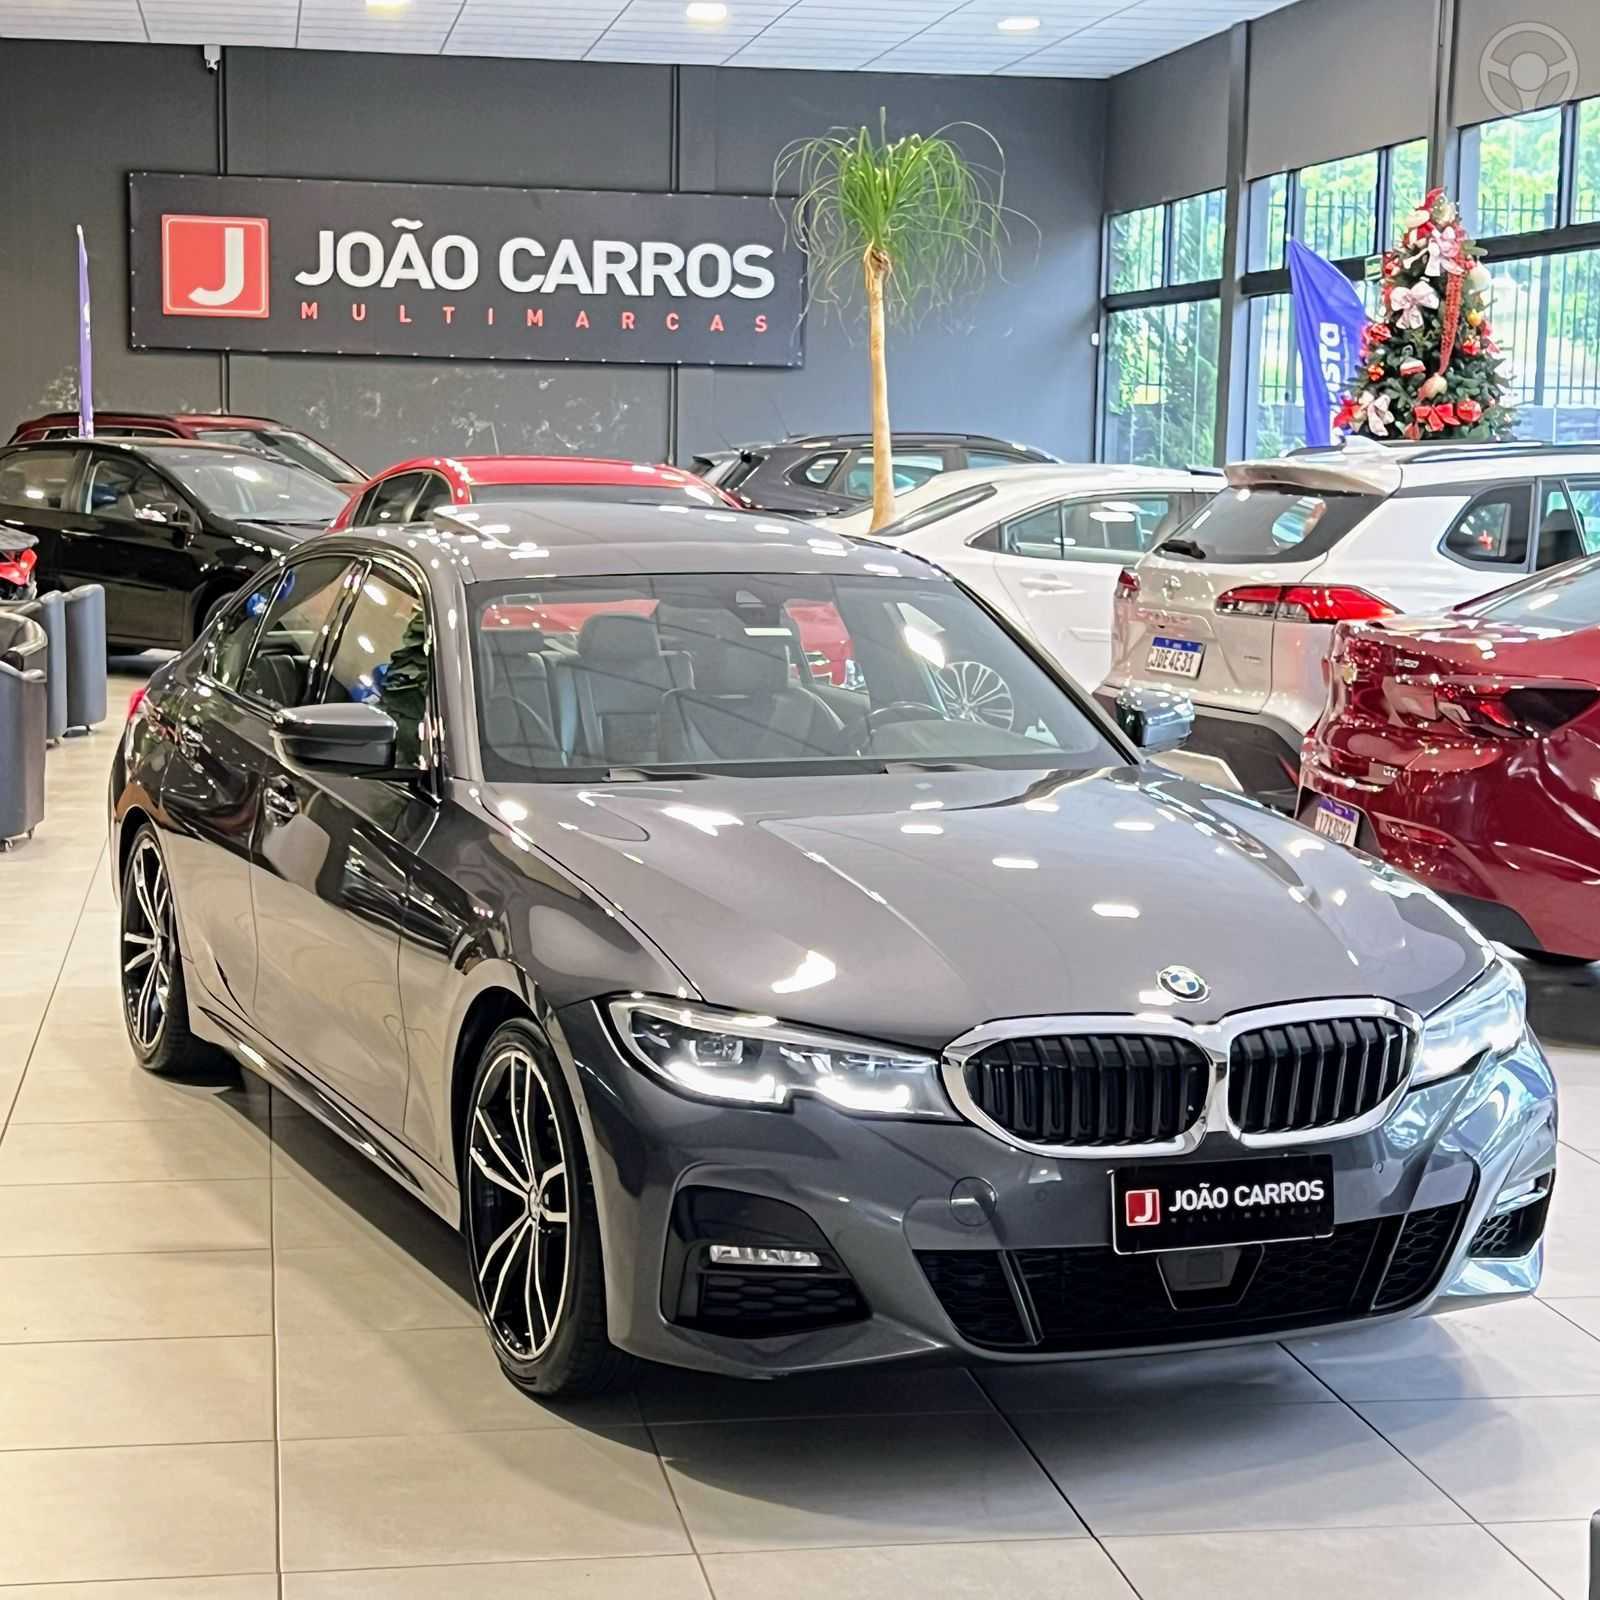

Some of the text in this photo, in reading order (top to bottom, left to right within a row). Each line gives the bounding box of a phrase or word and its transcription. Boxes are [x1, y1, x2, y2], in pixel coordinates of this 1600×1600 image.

[187, 226, 245, 307] J
[294, 217, 776, 300] JOÃO CARROS
[300, 301, 769, 333] MULTIMARCAS
[1134, 1190, 1153, 1223] J
[1168, 1179, 1325, 1213] JOÃO CARROS
